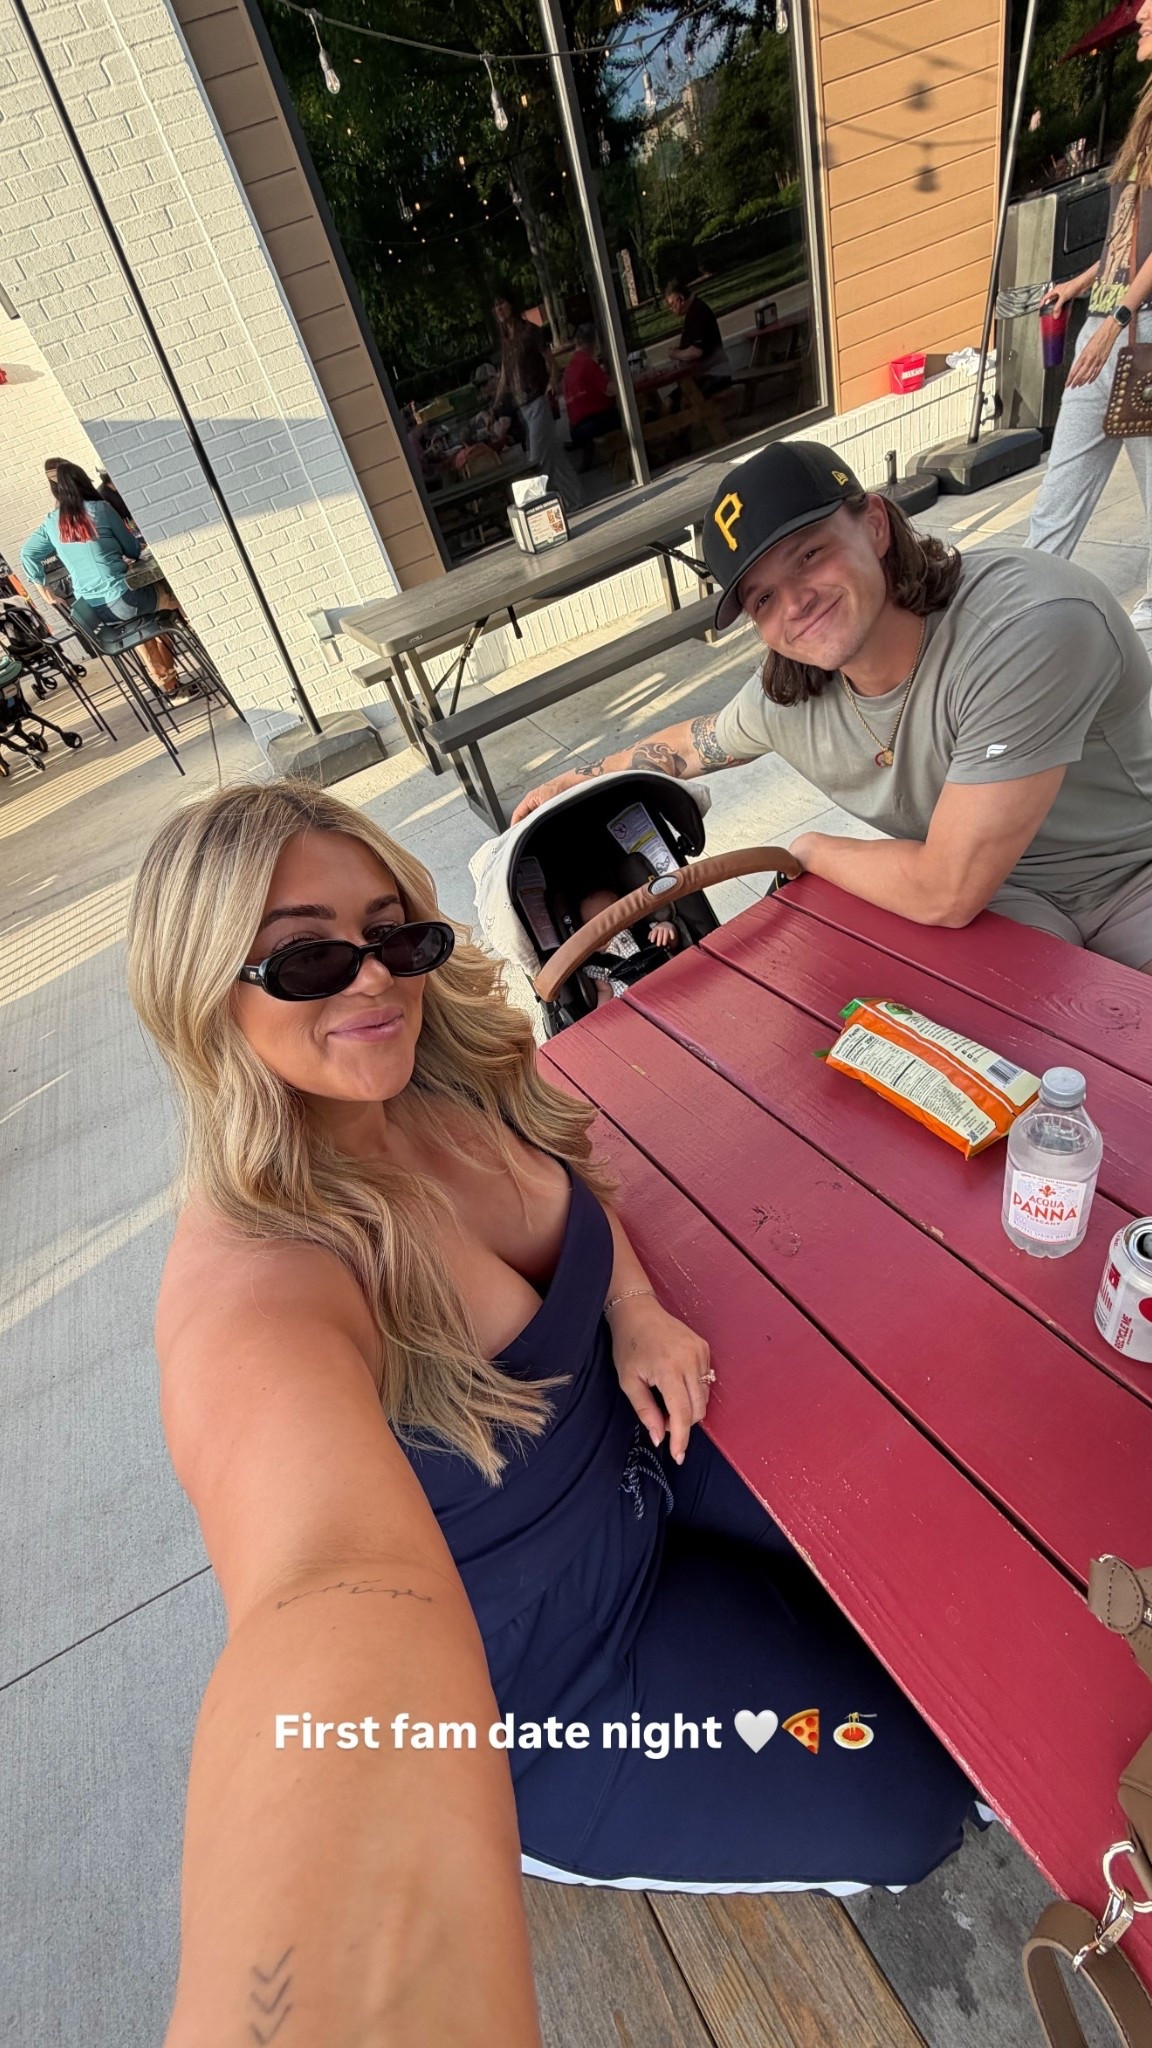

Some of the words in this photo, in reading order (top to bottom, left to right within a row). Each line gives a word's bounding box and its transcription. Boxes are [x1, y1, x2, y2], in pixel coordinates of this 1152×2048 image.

[714, 492, 743, 551] P
[1013, 1191, 1077, 1222] PANNA
[1029, 1195, 1065, 1209] ACQUA
